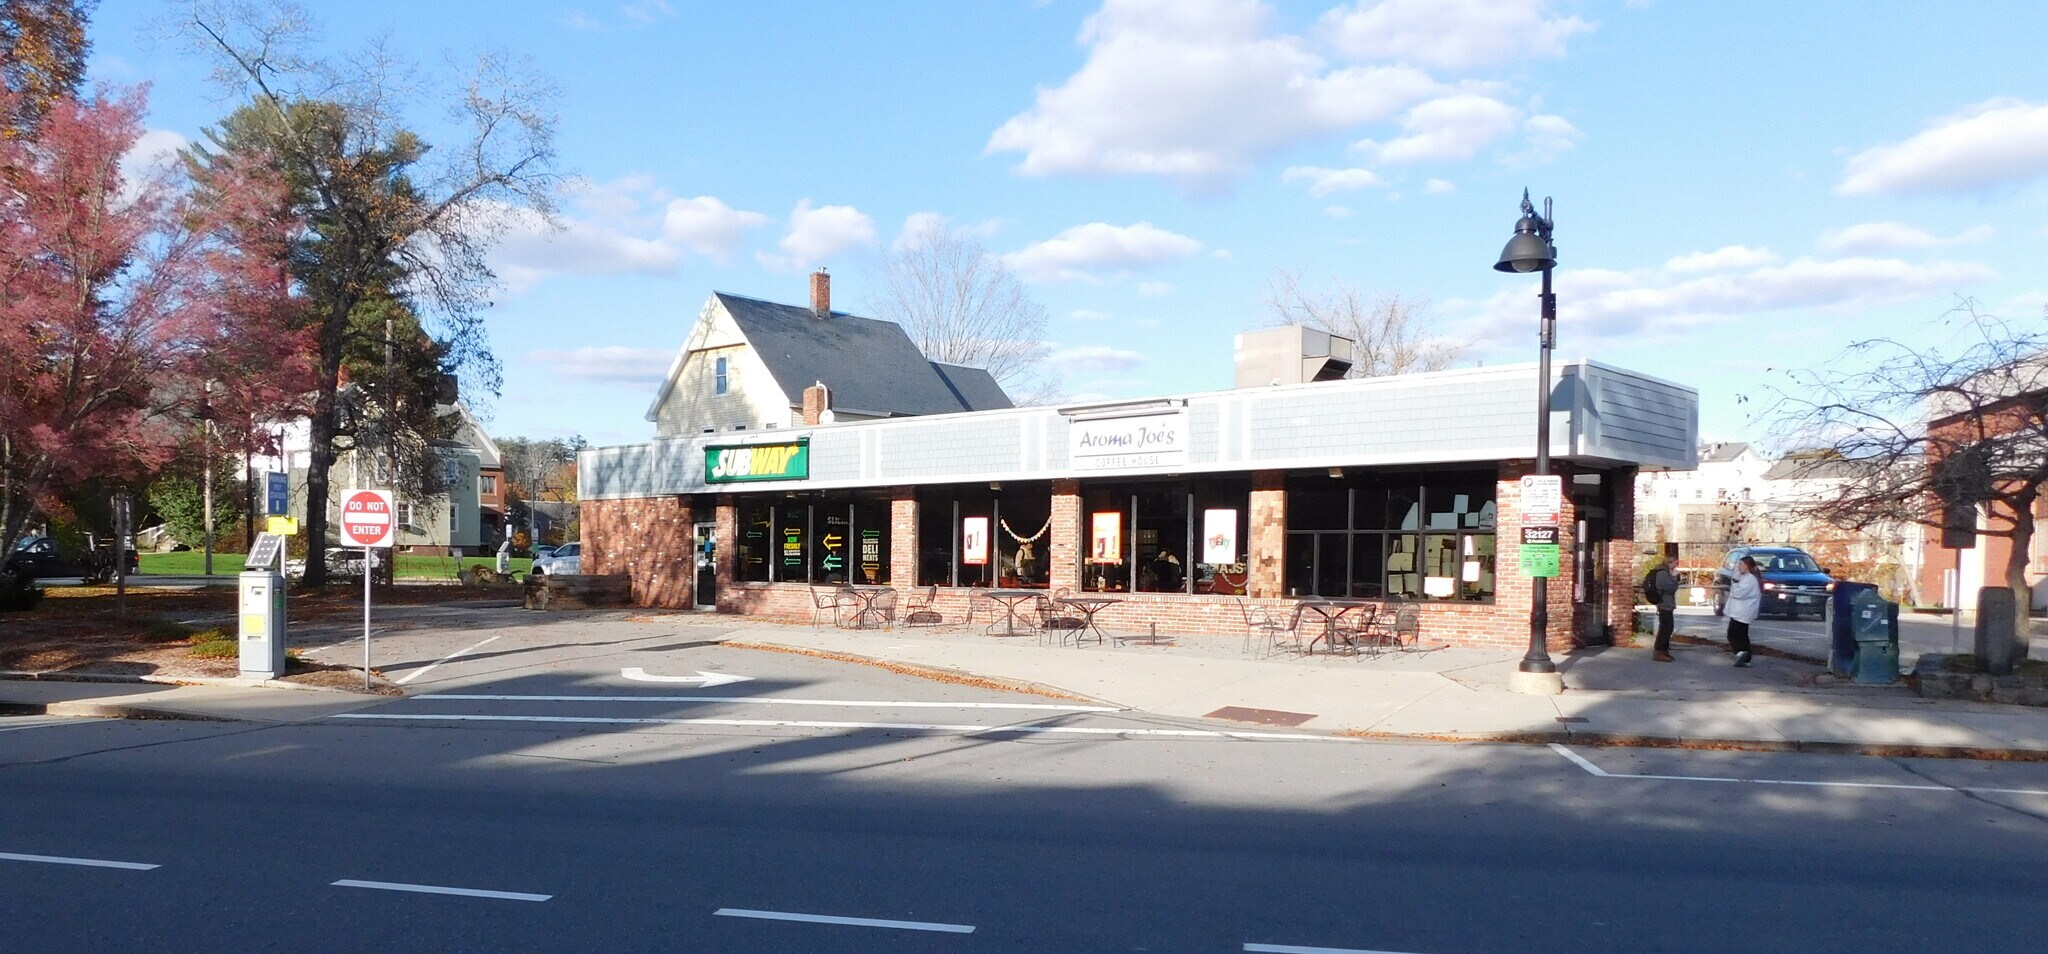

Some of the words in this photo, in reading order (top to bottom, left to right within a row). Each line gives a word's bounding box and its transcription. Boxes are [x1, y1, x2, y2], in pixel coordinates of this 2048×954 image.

[1080, 431, 1132, 448] Aroma
[1137, 423, 1175, 448] Joe's
[712, 443, 800, 480] SUBWAY
[1096, 457, 1126, 467] COFFEE
[1131, 455, 1159, 465] HOUSE
[349, 501, 362, 511] DO
[367, 502, 385, 512] NOT
[352, 525, 382, 535] ENTER
[1525, 531, 1554, 539] 32127
[863, 544, 878, 554] DELI
